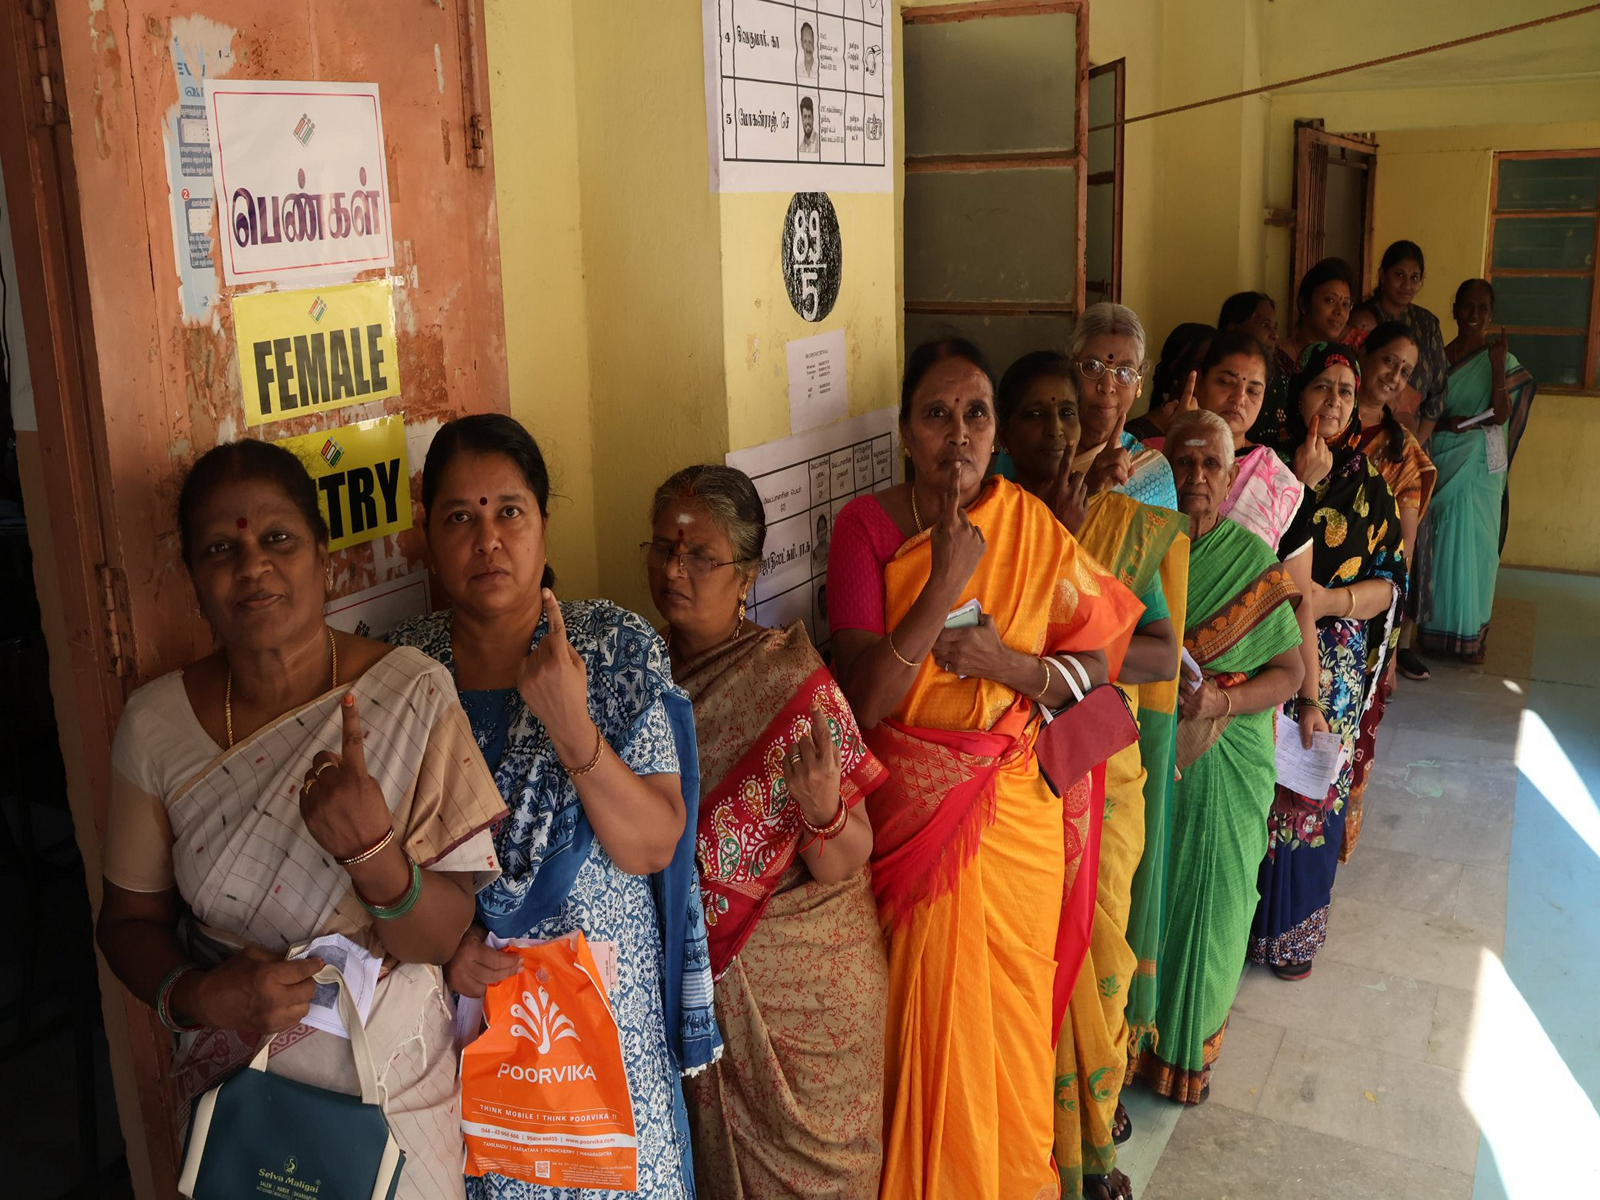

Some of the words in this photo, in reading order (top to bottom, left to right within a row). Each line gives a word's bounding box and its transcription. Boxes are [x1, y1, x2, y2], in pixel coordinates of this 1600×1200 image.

[724, 32, 730, 43] 4
[726, 113, 732, 124] 5
[232, 166, 381, 248] பெண்கள்
[793, 209, 821, 263] 89
[802, 272, 818, 322] 5
[253, 323, 388, 416] FEMALE
[312, 458, 400, 541] TRY
[497, 1062, 597, 1084] POORVIKA
[480, 1104, 503, 1114] THINK
[505, 1110, 534, 1120] MOBILE
[569, 1113, 609, 1123] POORVIKA
[565, 1137, 616, 1145] www.poorvika.com
[258, 1168, 284, 1182] Selva
[285, 1176, 319, 1193] Maligai
